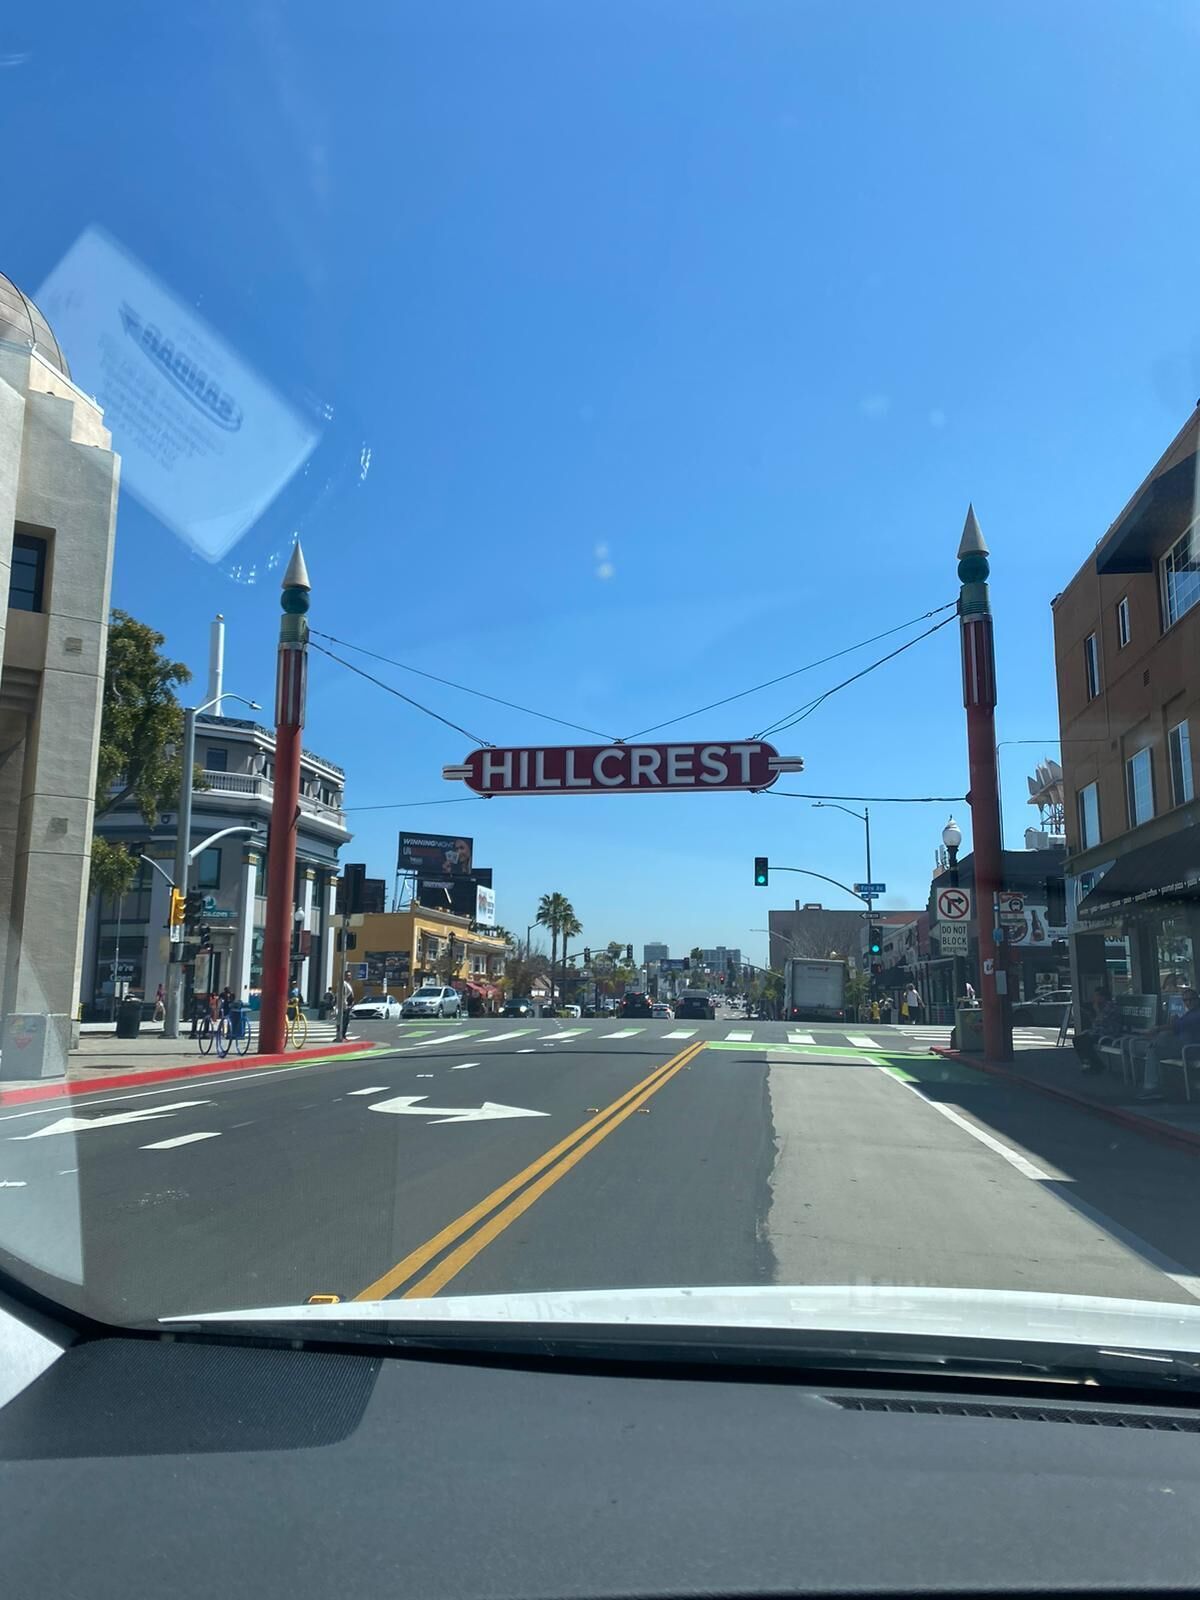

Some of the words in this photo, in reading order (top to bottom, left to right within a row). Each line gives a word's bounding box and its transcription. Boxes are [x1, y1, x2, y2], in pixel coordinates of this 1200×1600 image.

[482, 745, 761, 788] HILLCREST
[942, 926, 952, 934] DO
[953, 926, 966, 934] NOT
[942, 936, 967, 945] BLOCK
